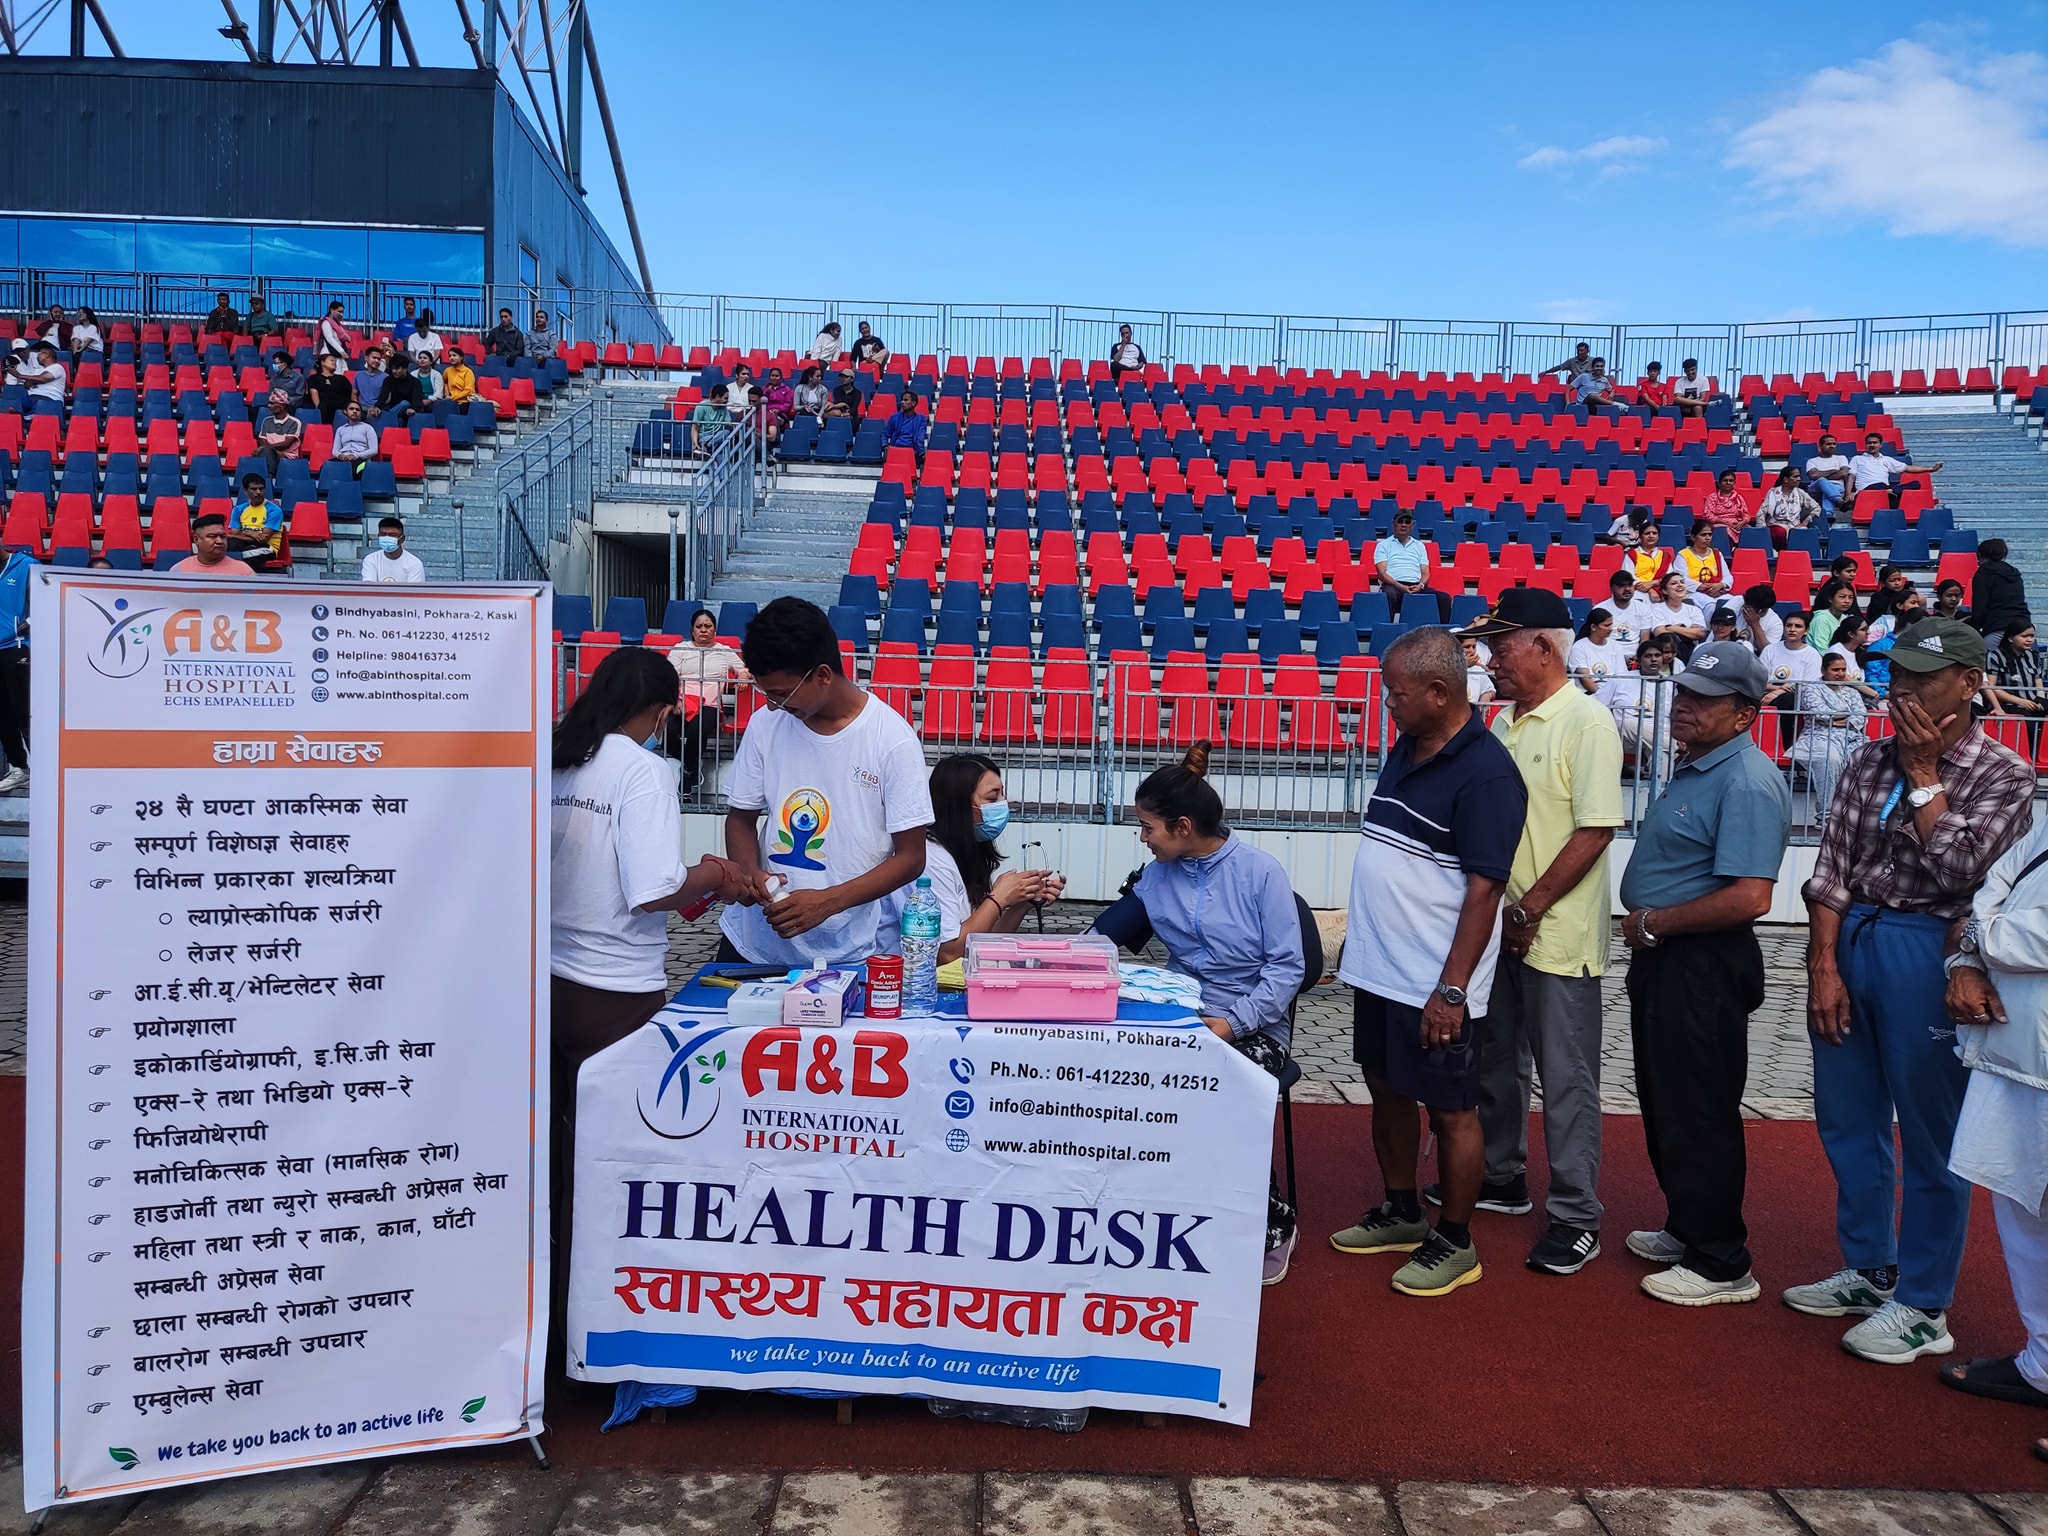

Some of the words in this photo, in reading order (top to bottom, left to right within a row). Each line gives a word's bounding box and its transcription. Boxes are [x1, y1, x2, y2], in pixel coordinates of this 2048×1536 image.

[335, 607, 420, 619] Bindhyabasini,
[424, 609, 484, 622] Pokhara-2,
[487, 611, 517, 620] Kaski
[336, 628, 355, 640] Ph.
[359, 629, 379, 640] No.
[382, 629, 448, 643] 061-412230,
[452, 632, 489, 640] 412512
[1918, 641, 1943, 653] adidas
[336, 649, 388, 663] Helpline:
[391, 652, 456, 661] 9804163734
[164, 664, 295, 677] INTERNATIONAL
[337, 670, 471, 681] info@abinthospital.com
[165, 679, 295, 694] HOSPITAL
[337, 691, 468, 701] www.abinthospital.com
[165, 697, 200, 706] ECHS
[205, 697, 294, 706] EMPANELLED
[213, 741, 277, 764] हाम्रा
[286, 735, 383, 764] सेवाहरू
[136, 801, 163, 821] २४
[203, 800, 256, 816] घण्टा
[266, 793, 363, 816] आकस्मिक
[372, 794, 408, 816] सेवा
[134, 831, 198, 858] सम्पूर्ण
[289, 831, 350, 853] सेवाहरु
[134, 868, 205, 890] विभिन्न
[214, 871, 295, 890] प्रकारका
[304, 864, 396, 888] शल्यक्रिया
[328, 900, 382, 923] सर्जरी
[187, 942, 238, 964] लेजर
[246, 938, 302, 962] सर्जरी
[347, 972, 385, 993] सेवा
[133, 1017, 237, 1040] प्रयोगशाला
[1118, 1031, 1201, 1051] Pokhara-2,
[398, 1040, 435, 1061] सेवा
[989, 1062, 1051, 1083] Ph.No.:
[1057, 1066, 1154, 1089] 061-412230,
[1161, 1074, 1219, 1091] 412512
[133, 1088, 208, 1117] एक्स-रे
[216, 1090, 255, 1108] तथा
[263, 1080, 334, 1104] भिडियो
[343, 1075, 413, 1103] एक्स-रे
[742, 1108, 905, 1135] INTERNATIONAL
[990, 1097, 1177, 1124] info@abinthospital.com
[133, 1120, 269, 1149] फिजियोथेरापी
[743, 1130, 906, 1158] HOSPITAL
[984, 1135, 1172, 1163] www.abinthospital.com
[133, 1159, 267, 1185] मनोचिकित्सक
[276, 1155, 314, 1177] सेवा
[326, 1147, 410, 1175] (मानसिक
[418, 1142, 459, 1165] रोग)
[226, 1198, 265, 1216] तथा
[272, 1189, 318, 1217] न्युरो
[327, 1182, 396, 1209] सम्बन्धी
[406, 1178, 464, 1199] अप्रेसन
[473, 1172, 508, 1193] सेवा
[133, 1237, 196, 1261] महिला
[205, 1236, 243, 1255] तथा
[252, 1227, 287, 1251] स्त्री
[296, 1230, 312, 1249] र
[320, 1226, 365, 1245] नाक,
[376, 1219, 420, 1237] कान,
[432, 1207, 476, 1230] घाँटी
[618, 1181, 969, 1257] HEALTH
[987, 1203, 1213, 1274] DESK
[133, 1271, 207, 1299] सम्बन्धी
[218, 1268, 279, 1290] अप्रेसन
[288, 1263, 325, 1285] सेवा
[133, 1315, 187, 1337] छाला
[196, 1302, 268, 1331] सम्बन्धी
[277, 1296, 339, 1323] रोगको
[347, 1289, 414, 1311] उपचार
[615, 1267, 826, 1320] स्वास्थ्य
[844, 1278, 1066, 1337] सहायता
[1083, 1293, 1199, 1348] कक्ष
[133, 1348, 210, 1372] बालरोग
[219, 1336, 291, 1365] सम्बन्धी
[300, 1330, 368, 1353] उपचार
[731, 1349, 758, 1362] we
[762, 1344, 809, 1366] take
[817, 1350, 856, 1367] you
[862, 1349, 911, 1367] back
[918, 1354, 936, 1368] to
[944, 1360, 970, 1373] an
[977, 1361, 1039, 1378] active
[1046, 1364, 1080, 1385] life
[133, 1385, 216, 1415] एम्बुलेन्स
[225, 1379, 264, 1401] सेवा
[158, 1445, 182, 1461] We
[187, 1439, 227, 1456] take
[233, 1435, 264, 1455] you
[270, 1426, 309, 1445] back
[314, 1423, 332, 1438] to
[337, 1422, 356, 1435] an
[362, 1414, 412, 1432] active
[418, 1407, 444, 1424] life
